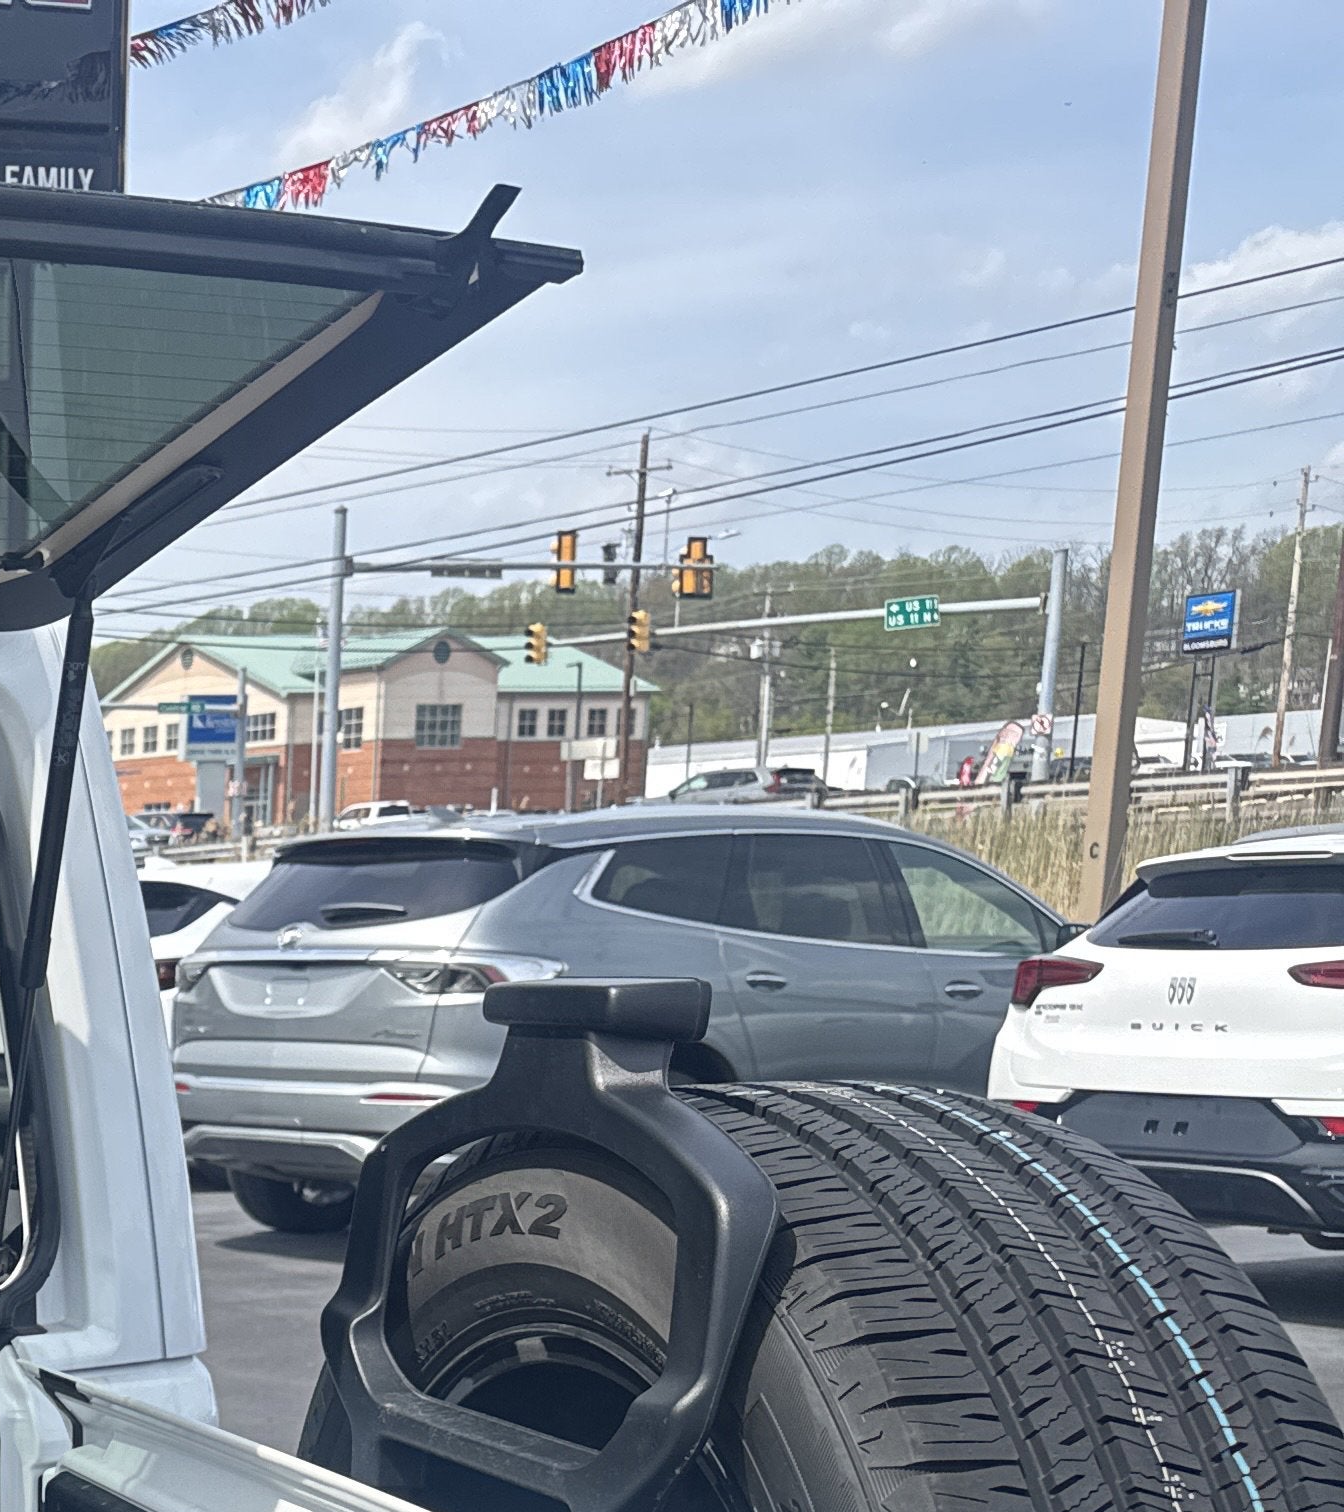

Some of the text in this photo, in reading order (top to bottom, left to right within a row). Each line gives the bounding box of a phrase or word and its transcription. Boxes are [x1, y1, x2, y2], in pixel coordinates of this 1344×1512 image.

[5, 165, 94, 191] FAMILY
[905, 600, 920, 612] US
[888, 611, 932, 626] US 11 N
[1185, 618, 1229, 632] TRUCKS
[1089, 842, 1099, 859] C
[1130, 1022, 1228, 1032] BUICK
[435, 1191, 568, 1261] HTX2
